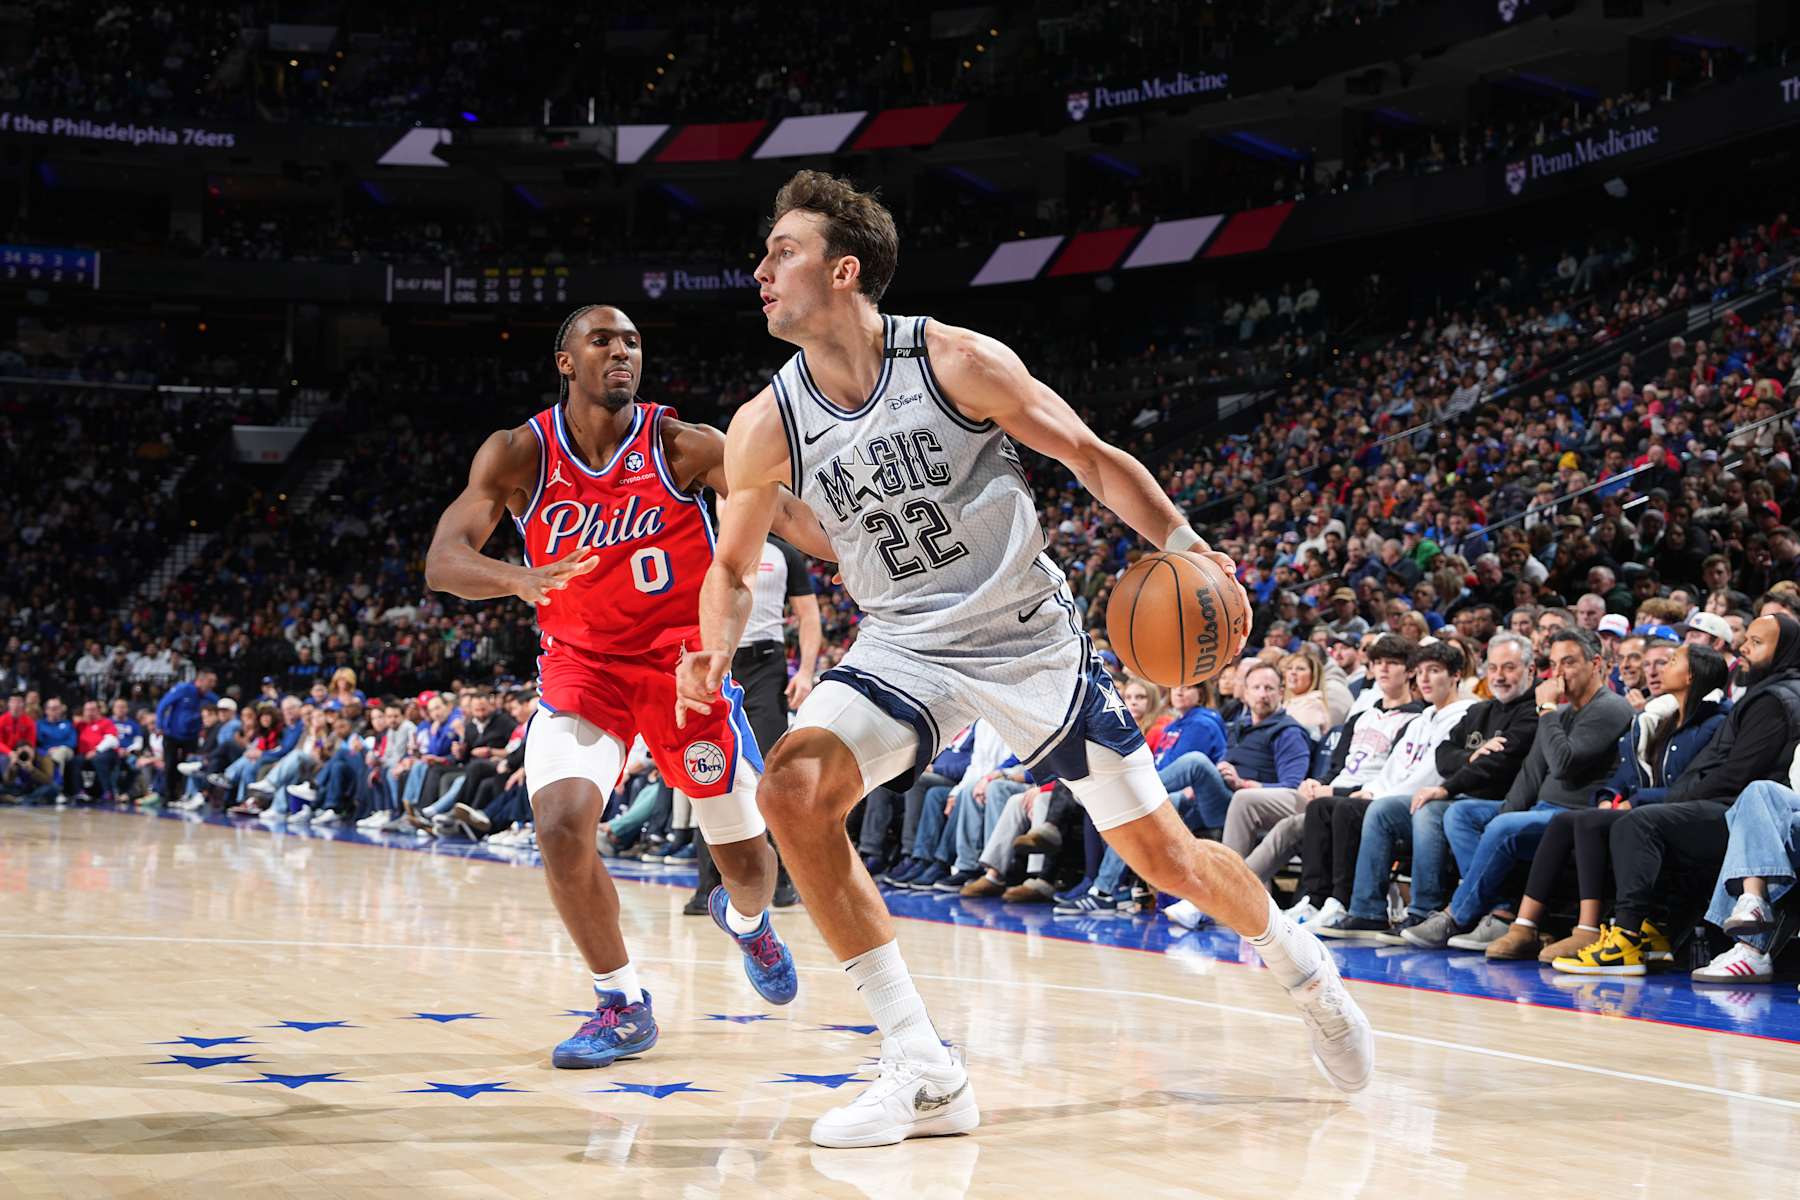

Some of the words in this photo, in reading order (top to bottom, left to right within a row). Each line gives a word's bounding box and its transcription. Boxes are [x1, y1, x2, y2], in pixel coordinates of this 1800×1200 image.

[1094, 87, 1139, 109] Penn
[1141, 71, 1228, 101] Medicine
[13, 113, 49, 134] the
[52, 117, 178, 146] Philadelphia
[182, 128, 235, 147] 76ers
[1531, 153, 1573, 178] Penn
[1575, 125, 1659, 166] Medicine
[673, 269, 720, 290] Penn
[896, 349, 911, 357] PW
[884, 393, 922, 410] Disney
[619, 473, 656, 484] crypto.com
[541, 495, 664, 554] Phila
[860, 497, 970, 581] 22
[629, 546, 674, 595] 0
[1192, 587, 1218, 677] Wilson
[688, 758, 722, 773] 76ers
